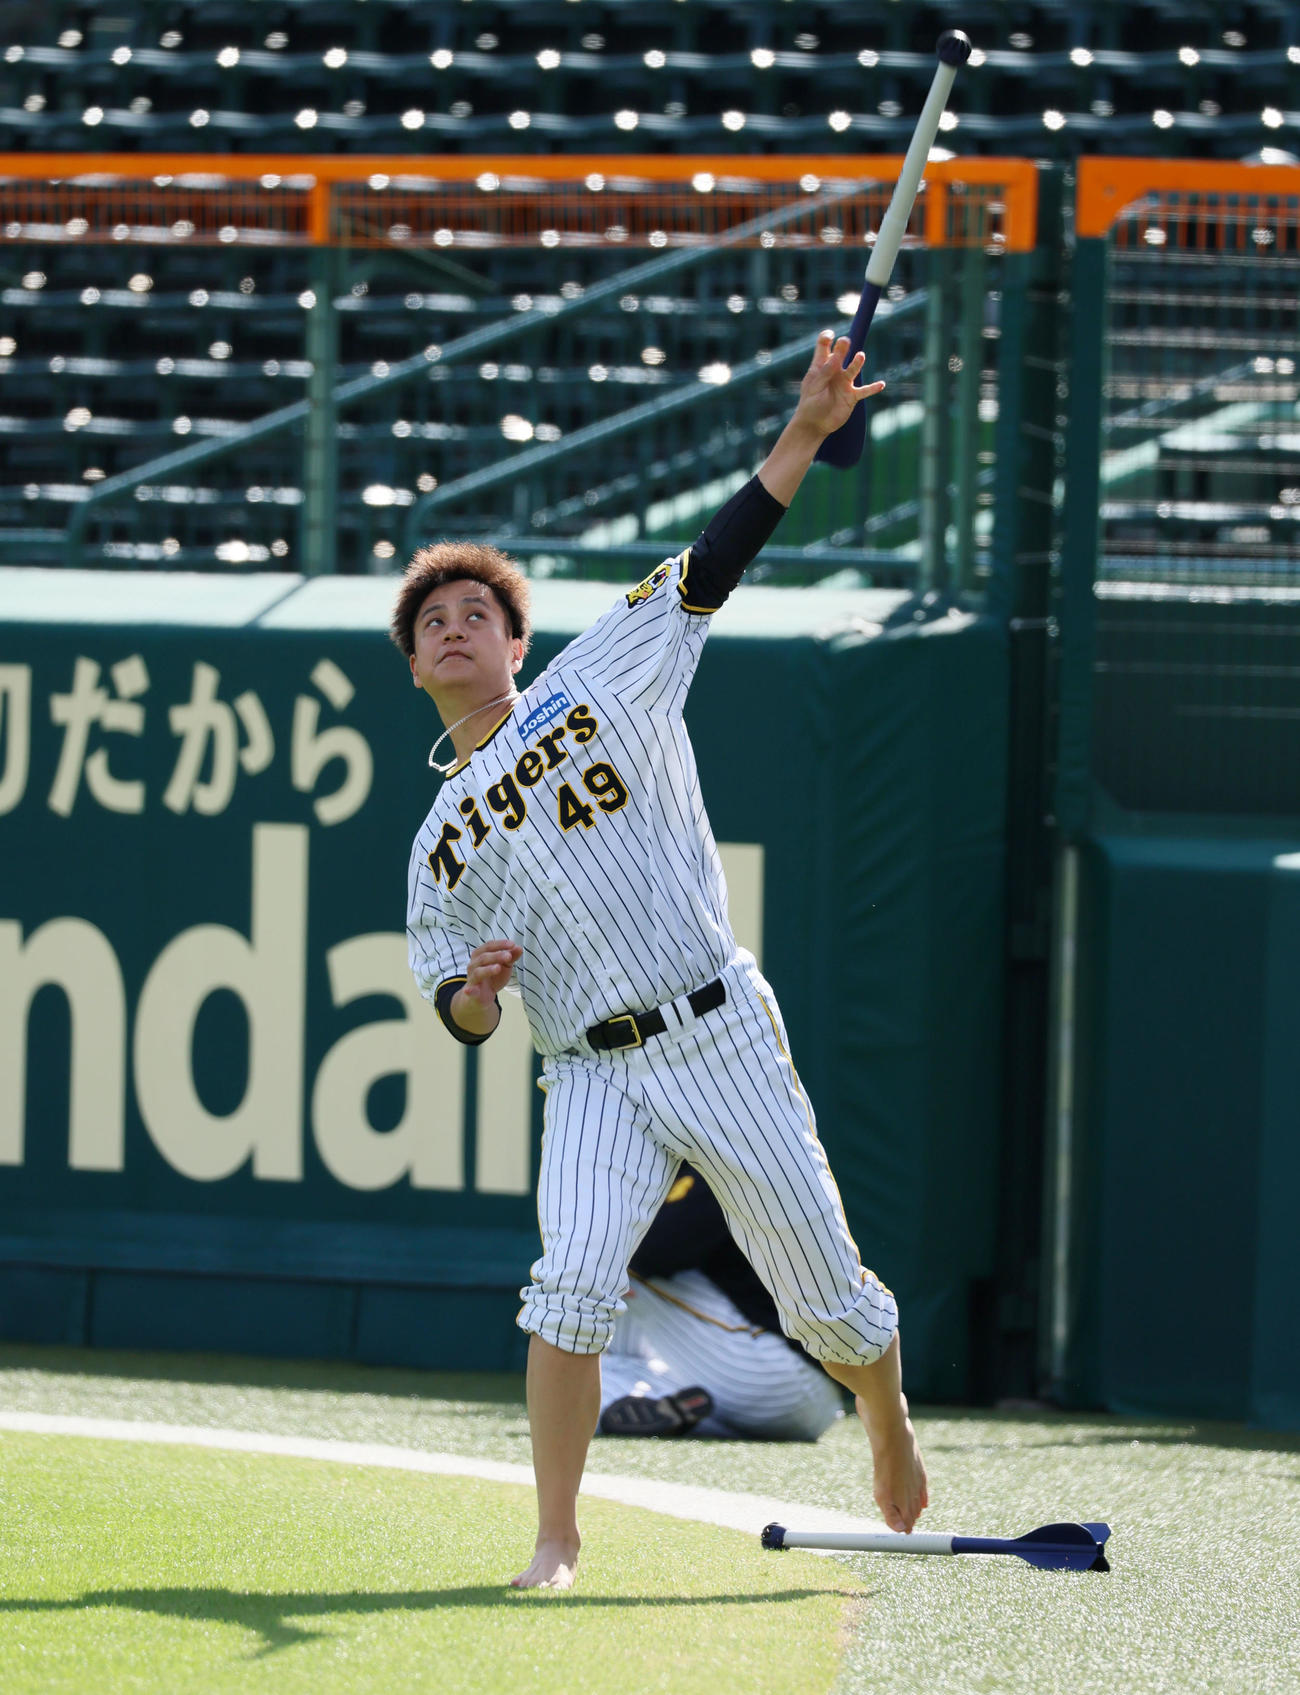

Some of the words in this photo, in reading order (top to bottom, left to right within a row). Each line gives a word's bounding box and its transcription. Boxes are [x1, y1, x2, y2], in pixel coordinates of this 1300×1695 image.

[521, 696, 568, 738] Joshin
[428, 703, 599, 892] Tigers
[556, 761, 630, 833] 49
